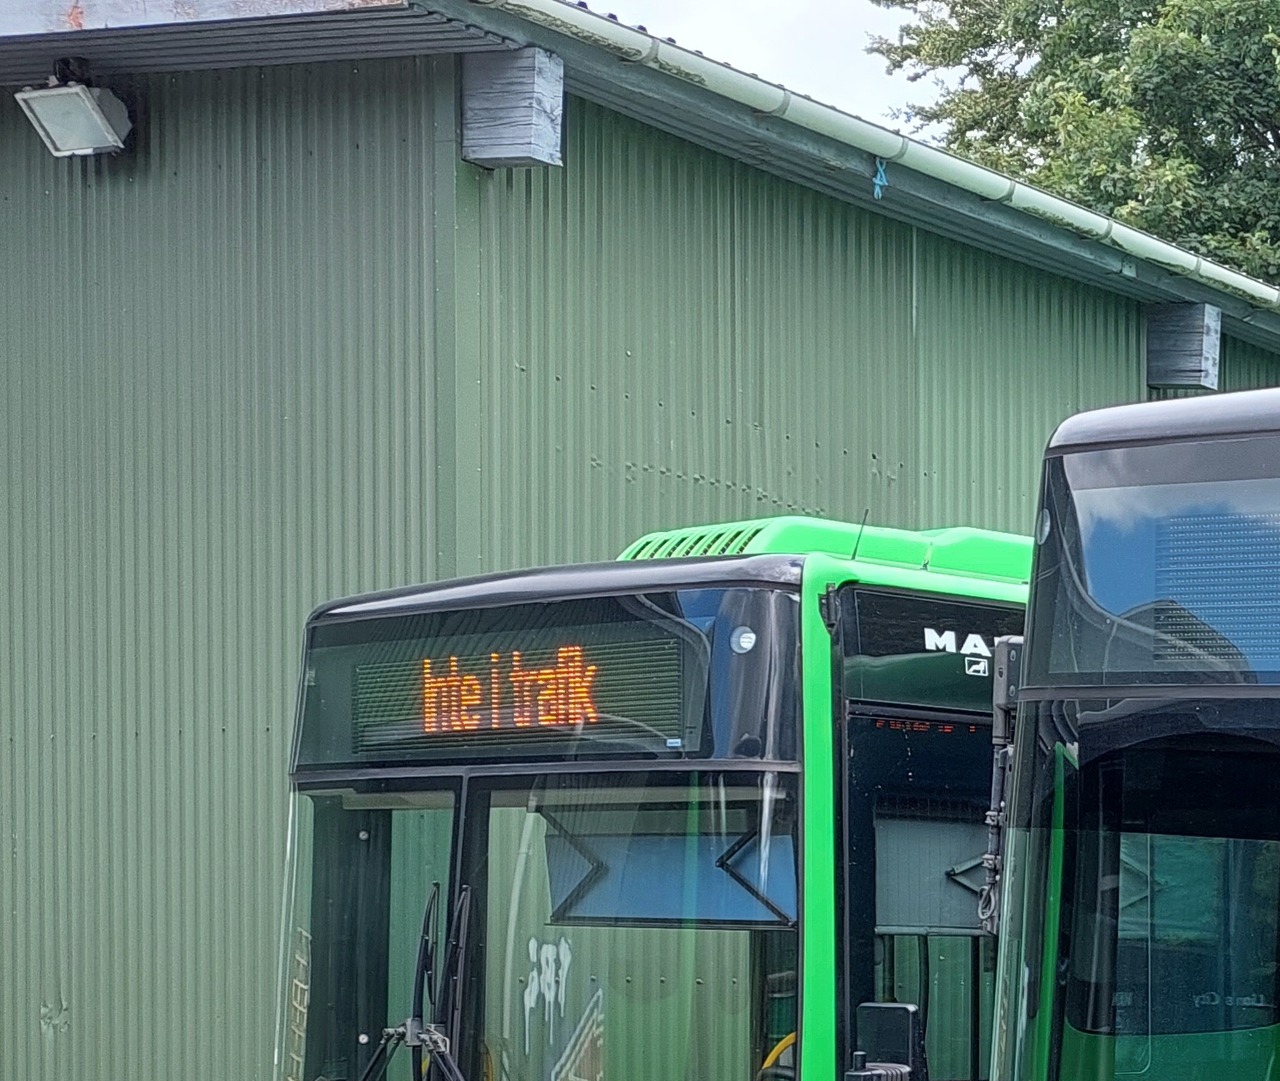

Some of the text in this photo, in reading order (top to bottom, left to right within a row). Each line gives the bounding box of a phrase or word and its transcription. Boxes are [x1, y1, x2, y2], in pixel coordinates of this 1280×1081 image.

[924, 628, 999, 657] MA
[423, 646, 598, 732] Inte i trafik
